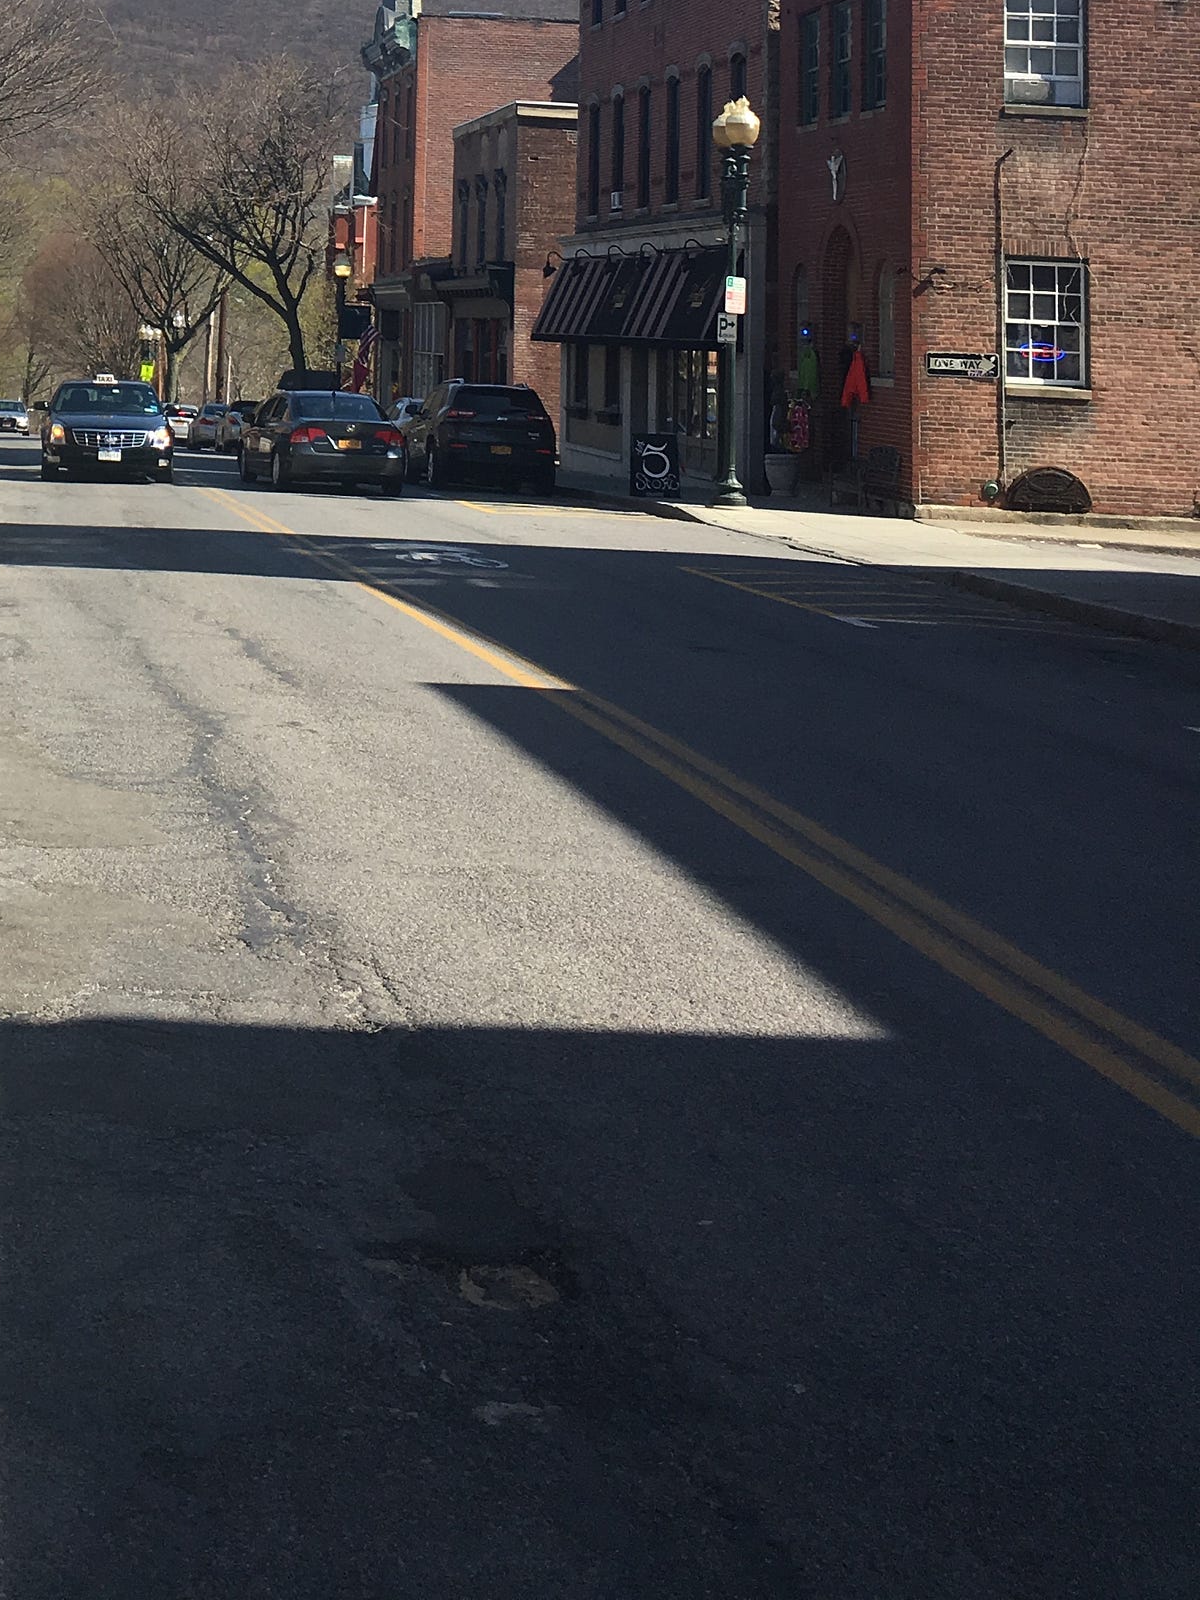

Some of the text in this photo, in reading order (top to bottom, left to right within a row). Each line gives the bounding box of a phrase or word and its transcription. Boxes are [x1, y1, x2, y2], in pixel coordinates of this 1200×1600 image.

[934, 358, 982, 370] ONE WAY
[641, 443, 670, 479] 5
